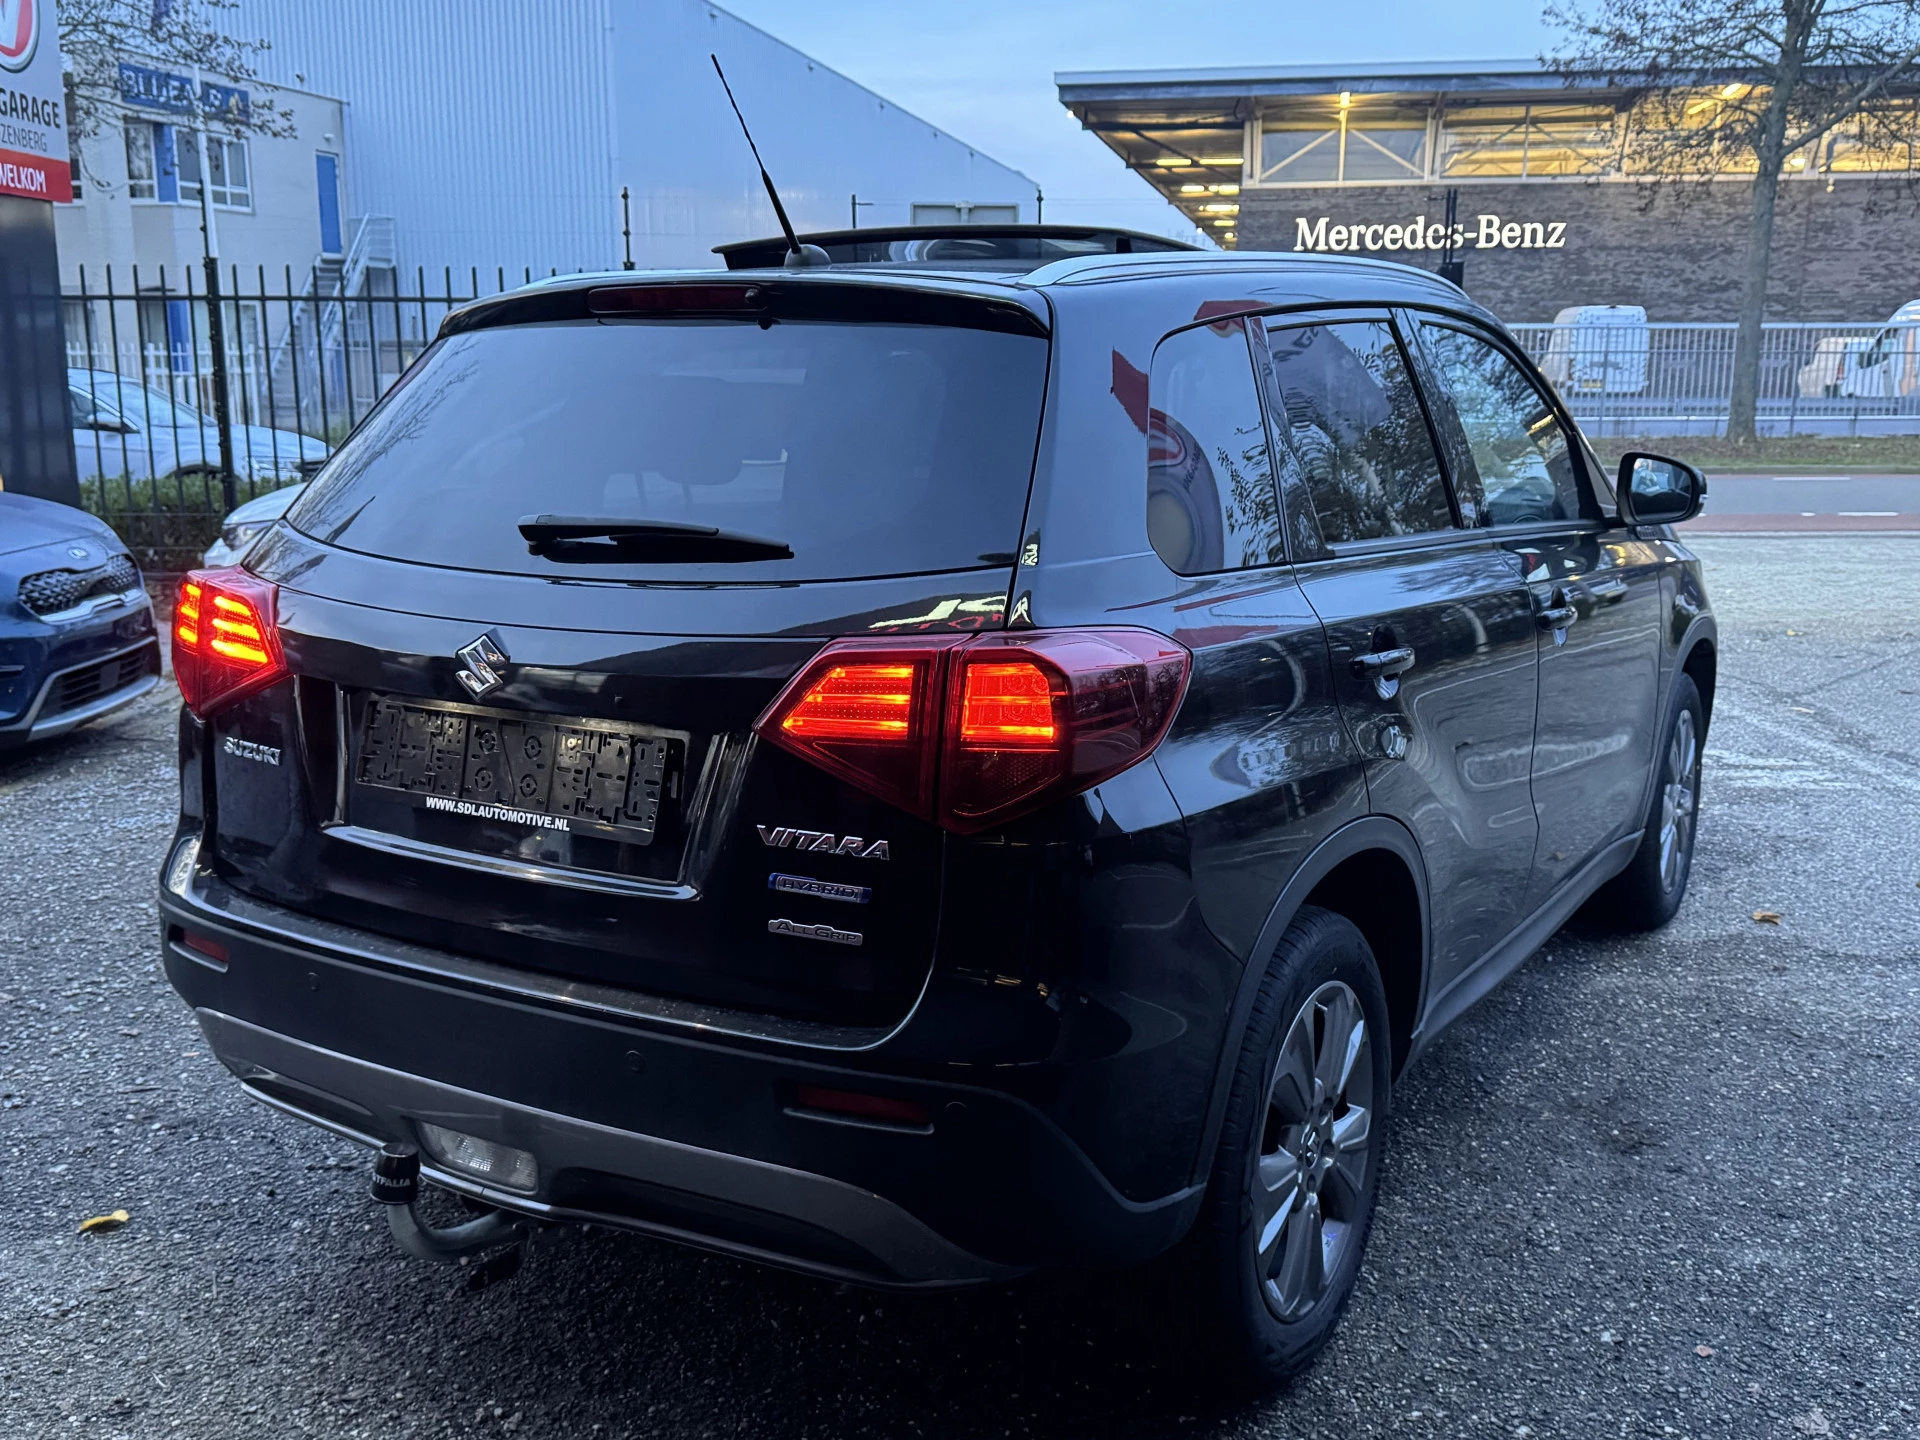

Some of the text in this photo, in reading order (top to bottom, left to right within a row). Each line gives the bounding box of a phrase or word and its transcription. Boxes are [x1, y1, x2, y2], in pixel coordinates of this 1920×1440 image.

[1293, 214, 1567, 251] Mercedes-Benz
[223, 736, 281, 766] SUZUKI
[426, 796, 570, 831] WWW.SDLAUTOMOTIVE.NL
[756, 824, 890, 861] VITARA
[783, 880, 856, 899] HYBRID
